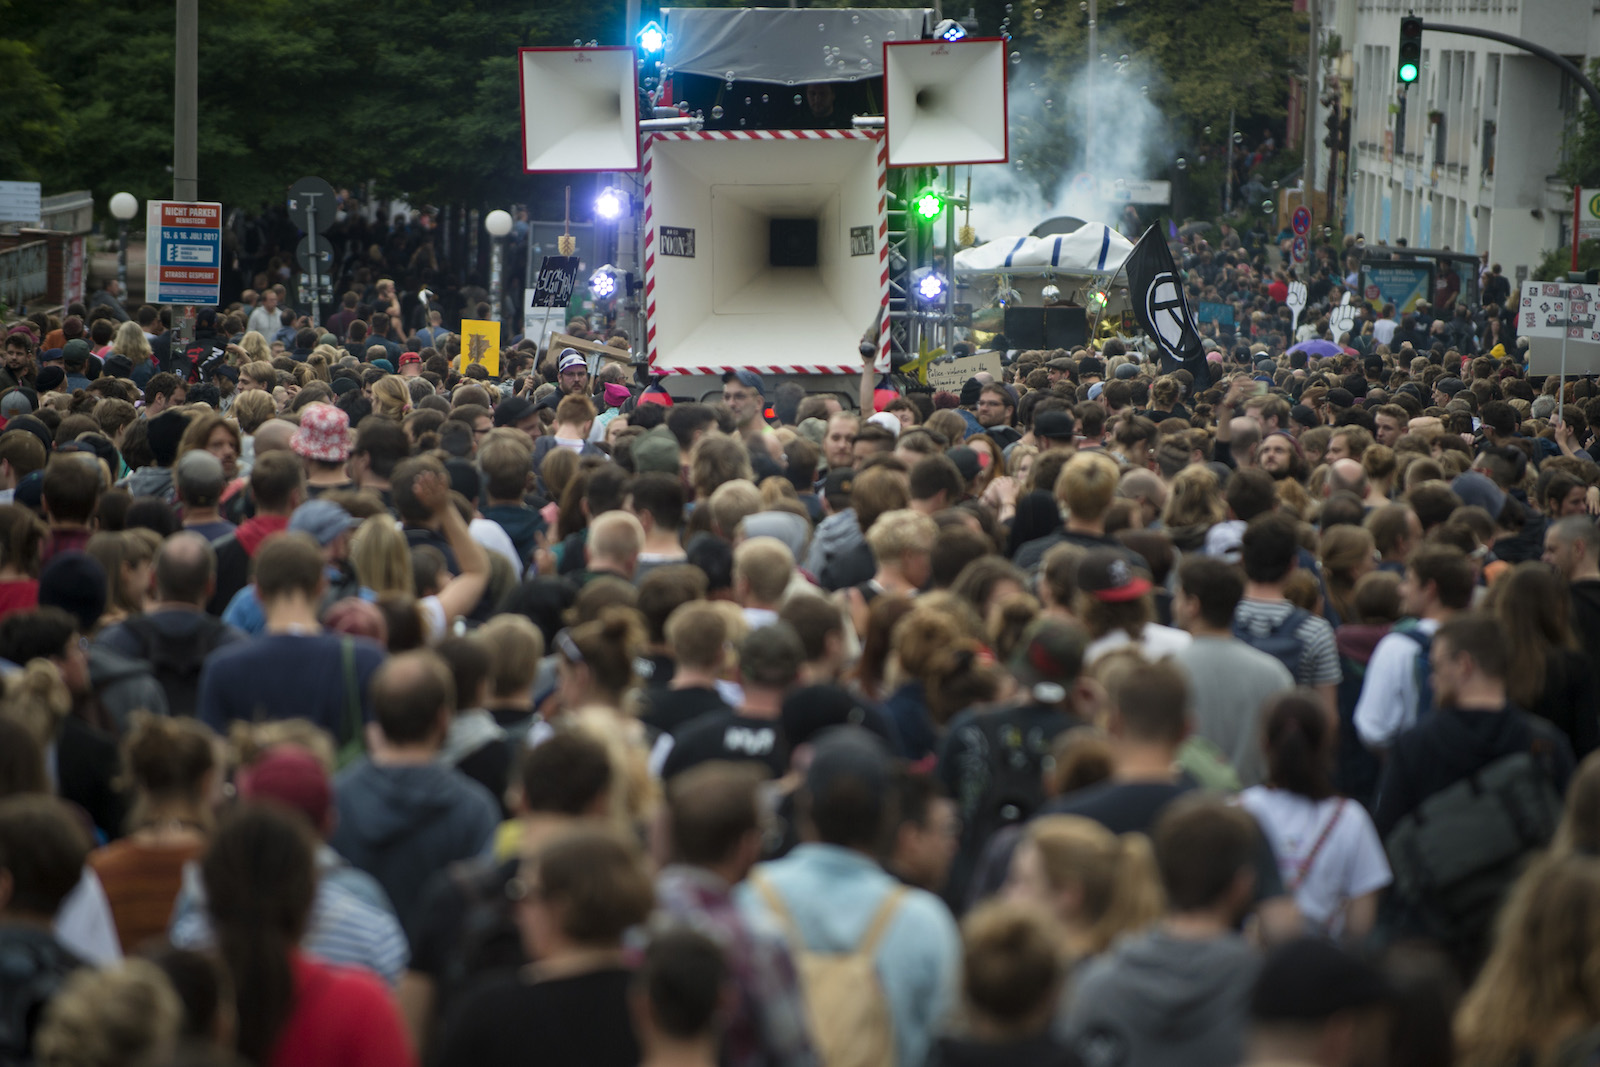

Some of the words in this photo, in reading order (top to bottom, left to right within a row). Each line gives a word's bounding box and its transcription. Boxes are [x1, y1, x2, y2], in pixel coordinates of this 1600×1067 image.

[165, 206, 187, 217] NICHT
[189, 207, 217, 218] PARKEN
[163, 231, 172, 239] 15.
[173, 231, 179, 240] &
[179, 231, 189, 240] 16.
[189, 232, 203, 241] JULI
[203, 232, 219, 241] 2017
[164, 270, 188, 279] STRASSE
[188, 271, 215, 280] GESPERRT
